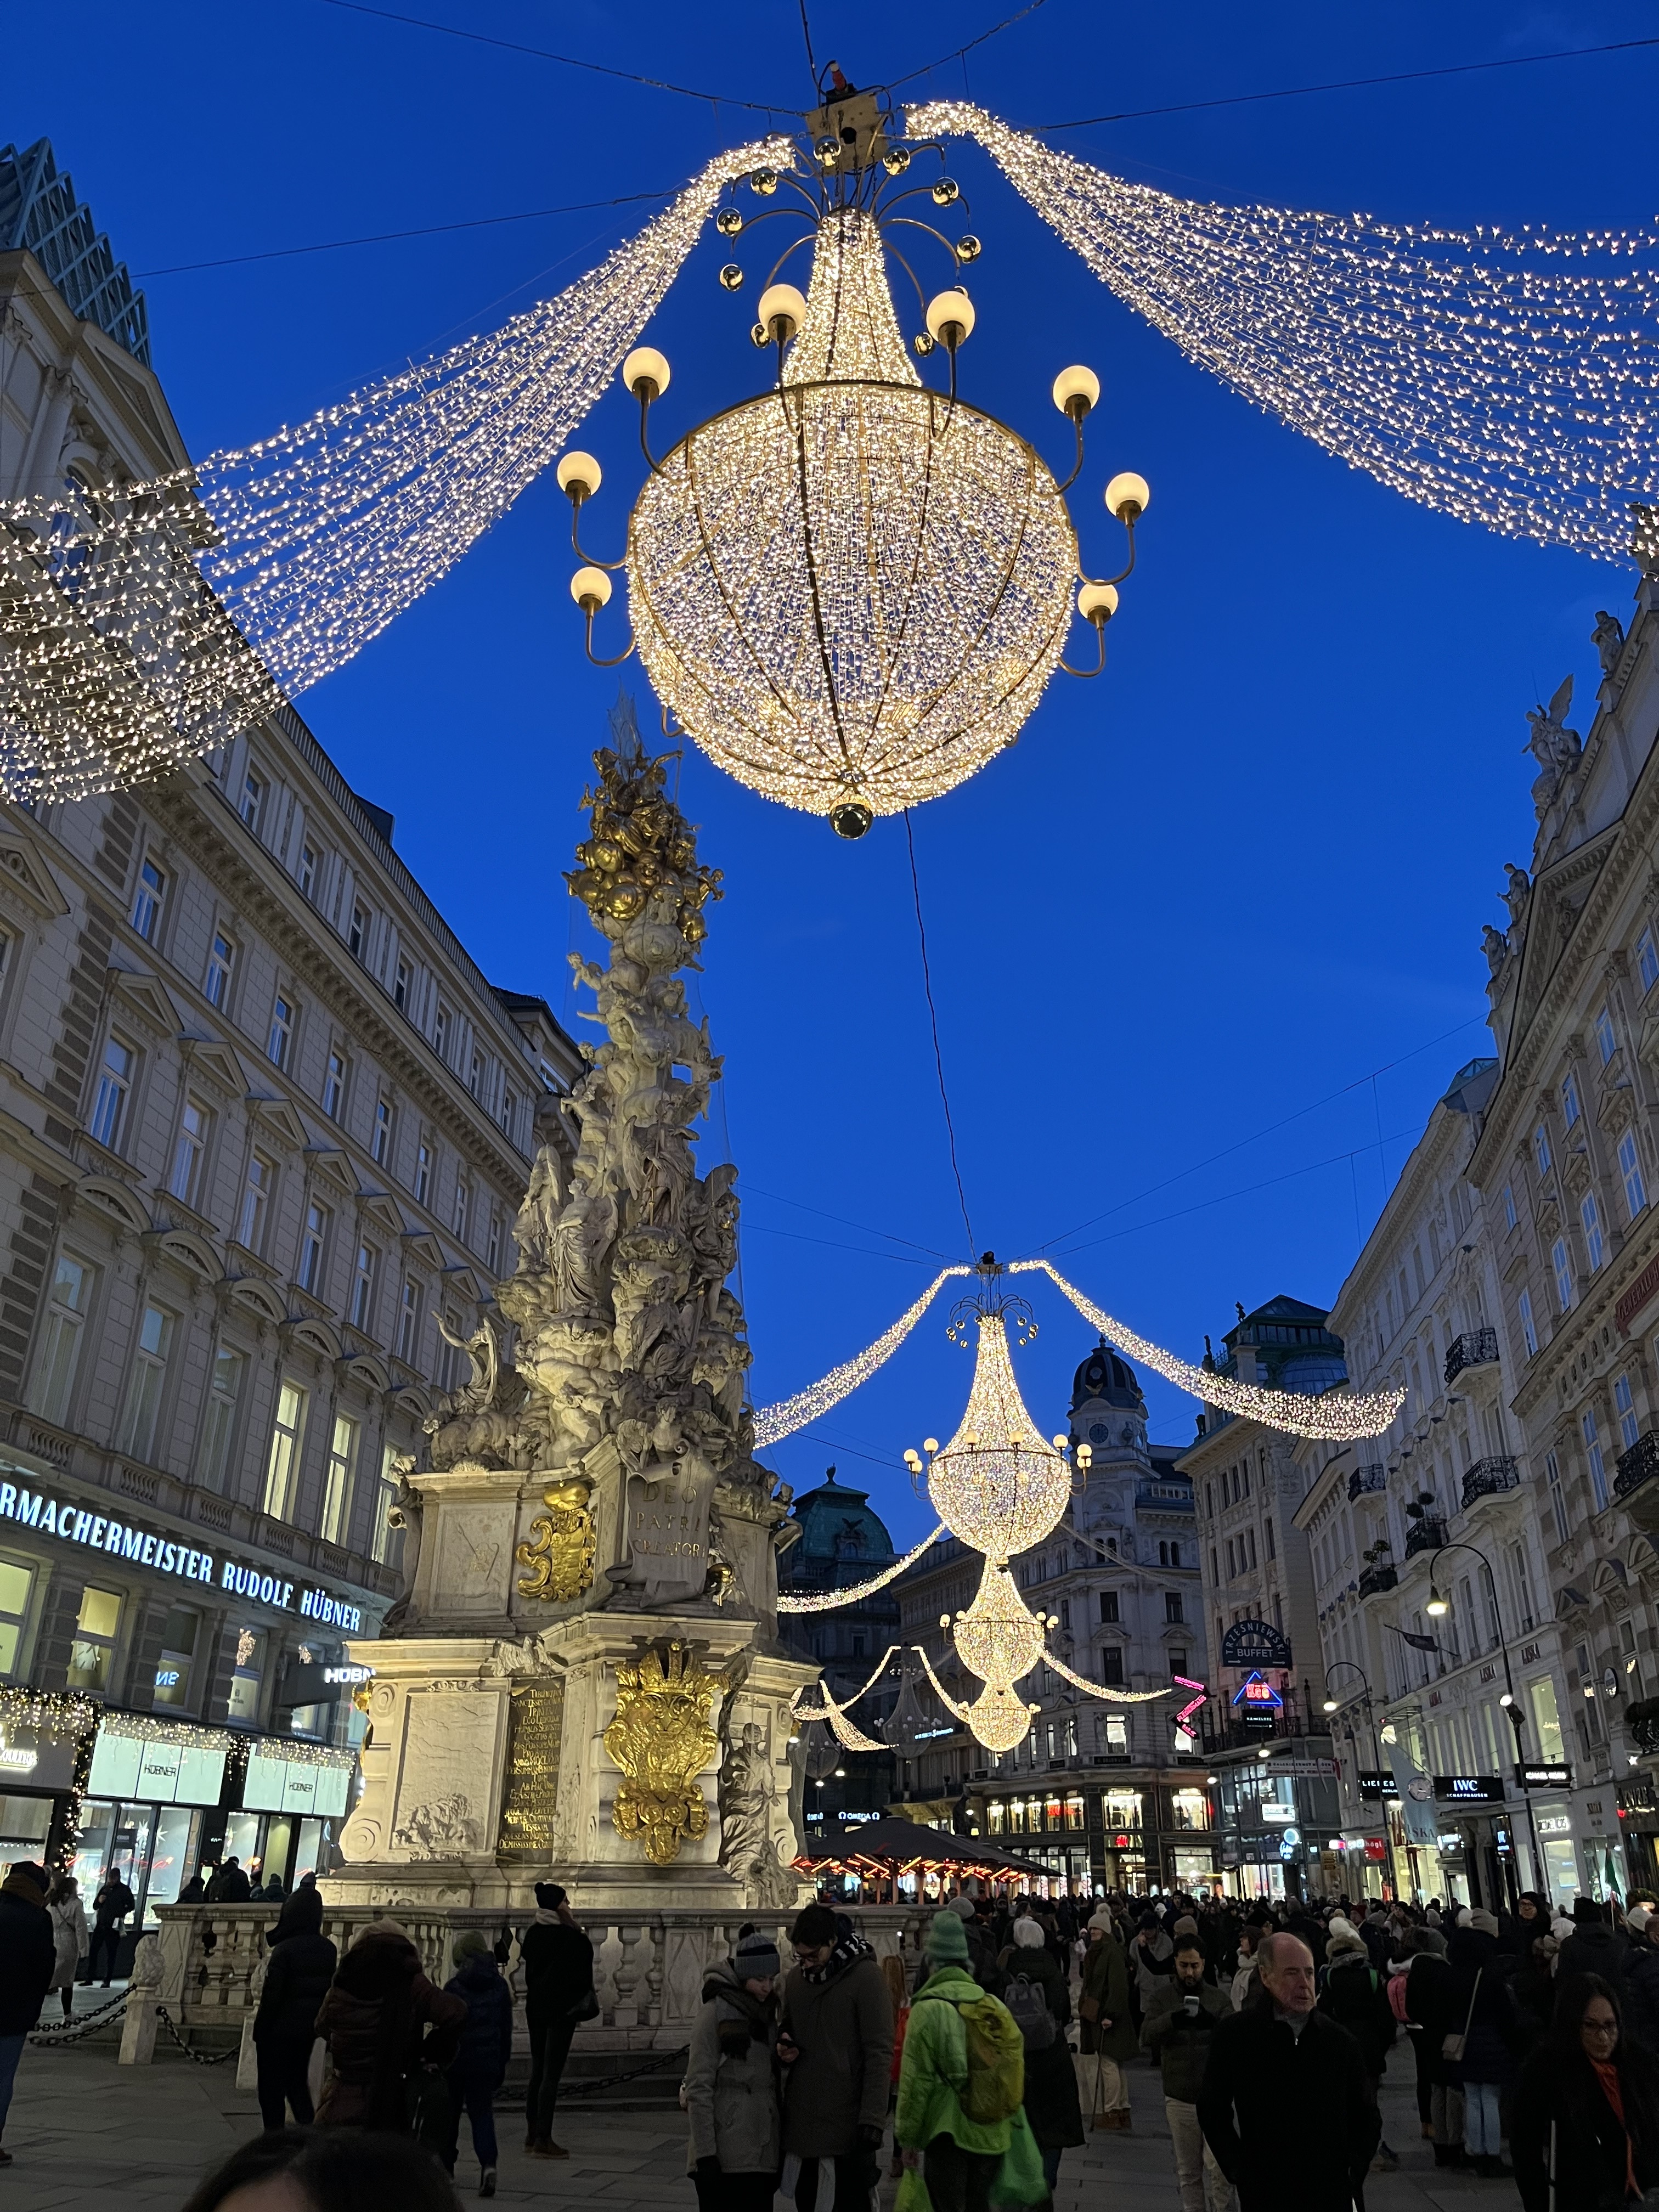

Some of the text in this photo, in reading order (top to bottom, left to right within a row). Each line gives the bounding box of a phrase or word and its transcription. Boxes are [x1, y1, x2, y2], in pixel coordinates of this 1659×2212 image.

[1618, 1261, 1659, 1320] GENERALI-H
[643, 1483, 697, 1504] DEO
[634, 1512, 700, 1531] PATRI
[0, 1482, 360, 1632] RMACHERMEISTER RUDOLF HÜBNER
[632, 1538, 707, 1559] CREATORI
[1237, 1648, 1273, 1657] BUFFET
[1453, 1780, 1477, 1791] IWC
[1365, 1841, 1382, 1849] högl
